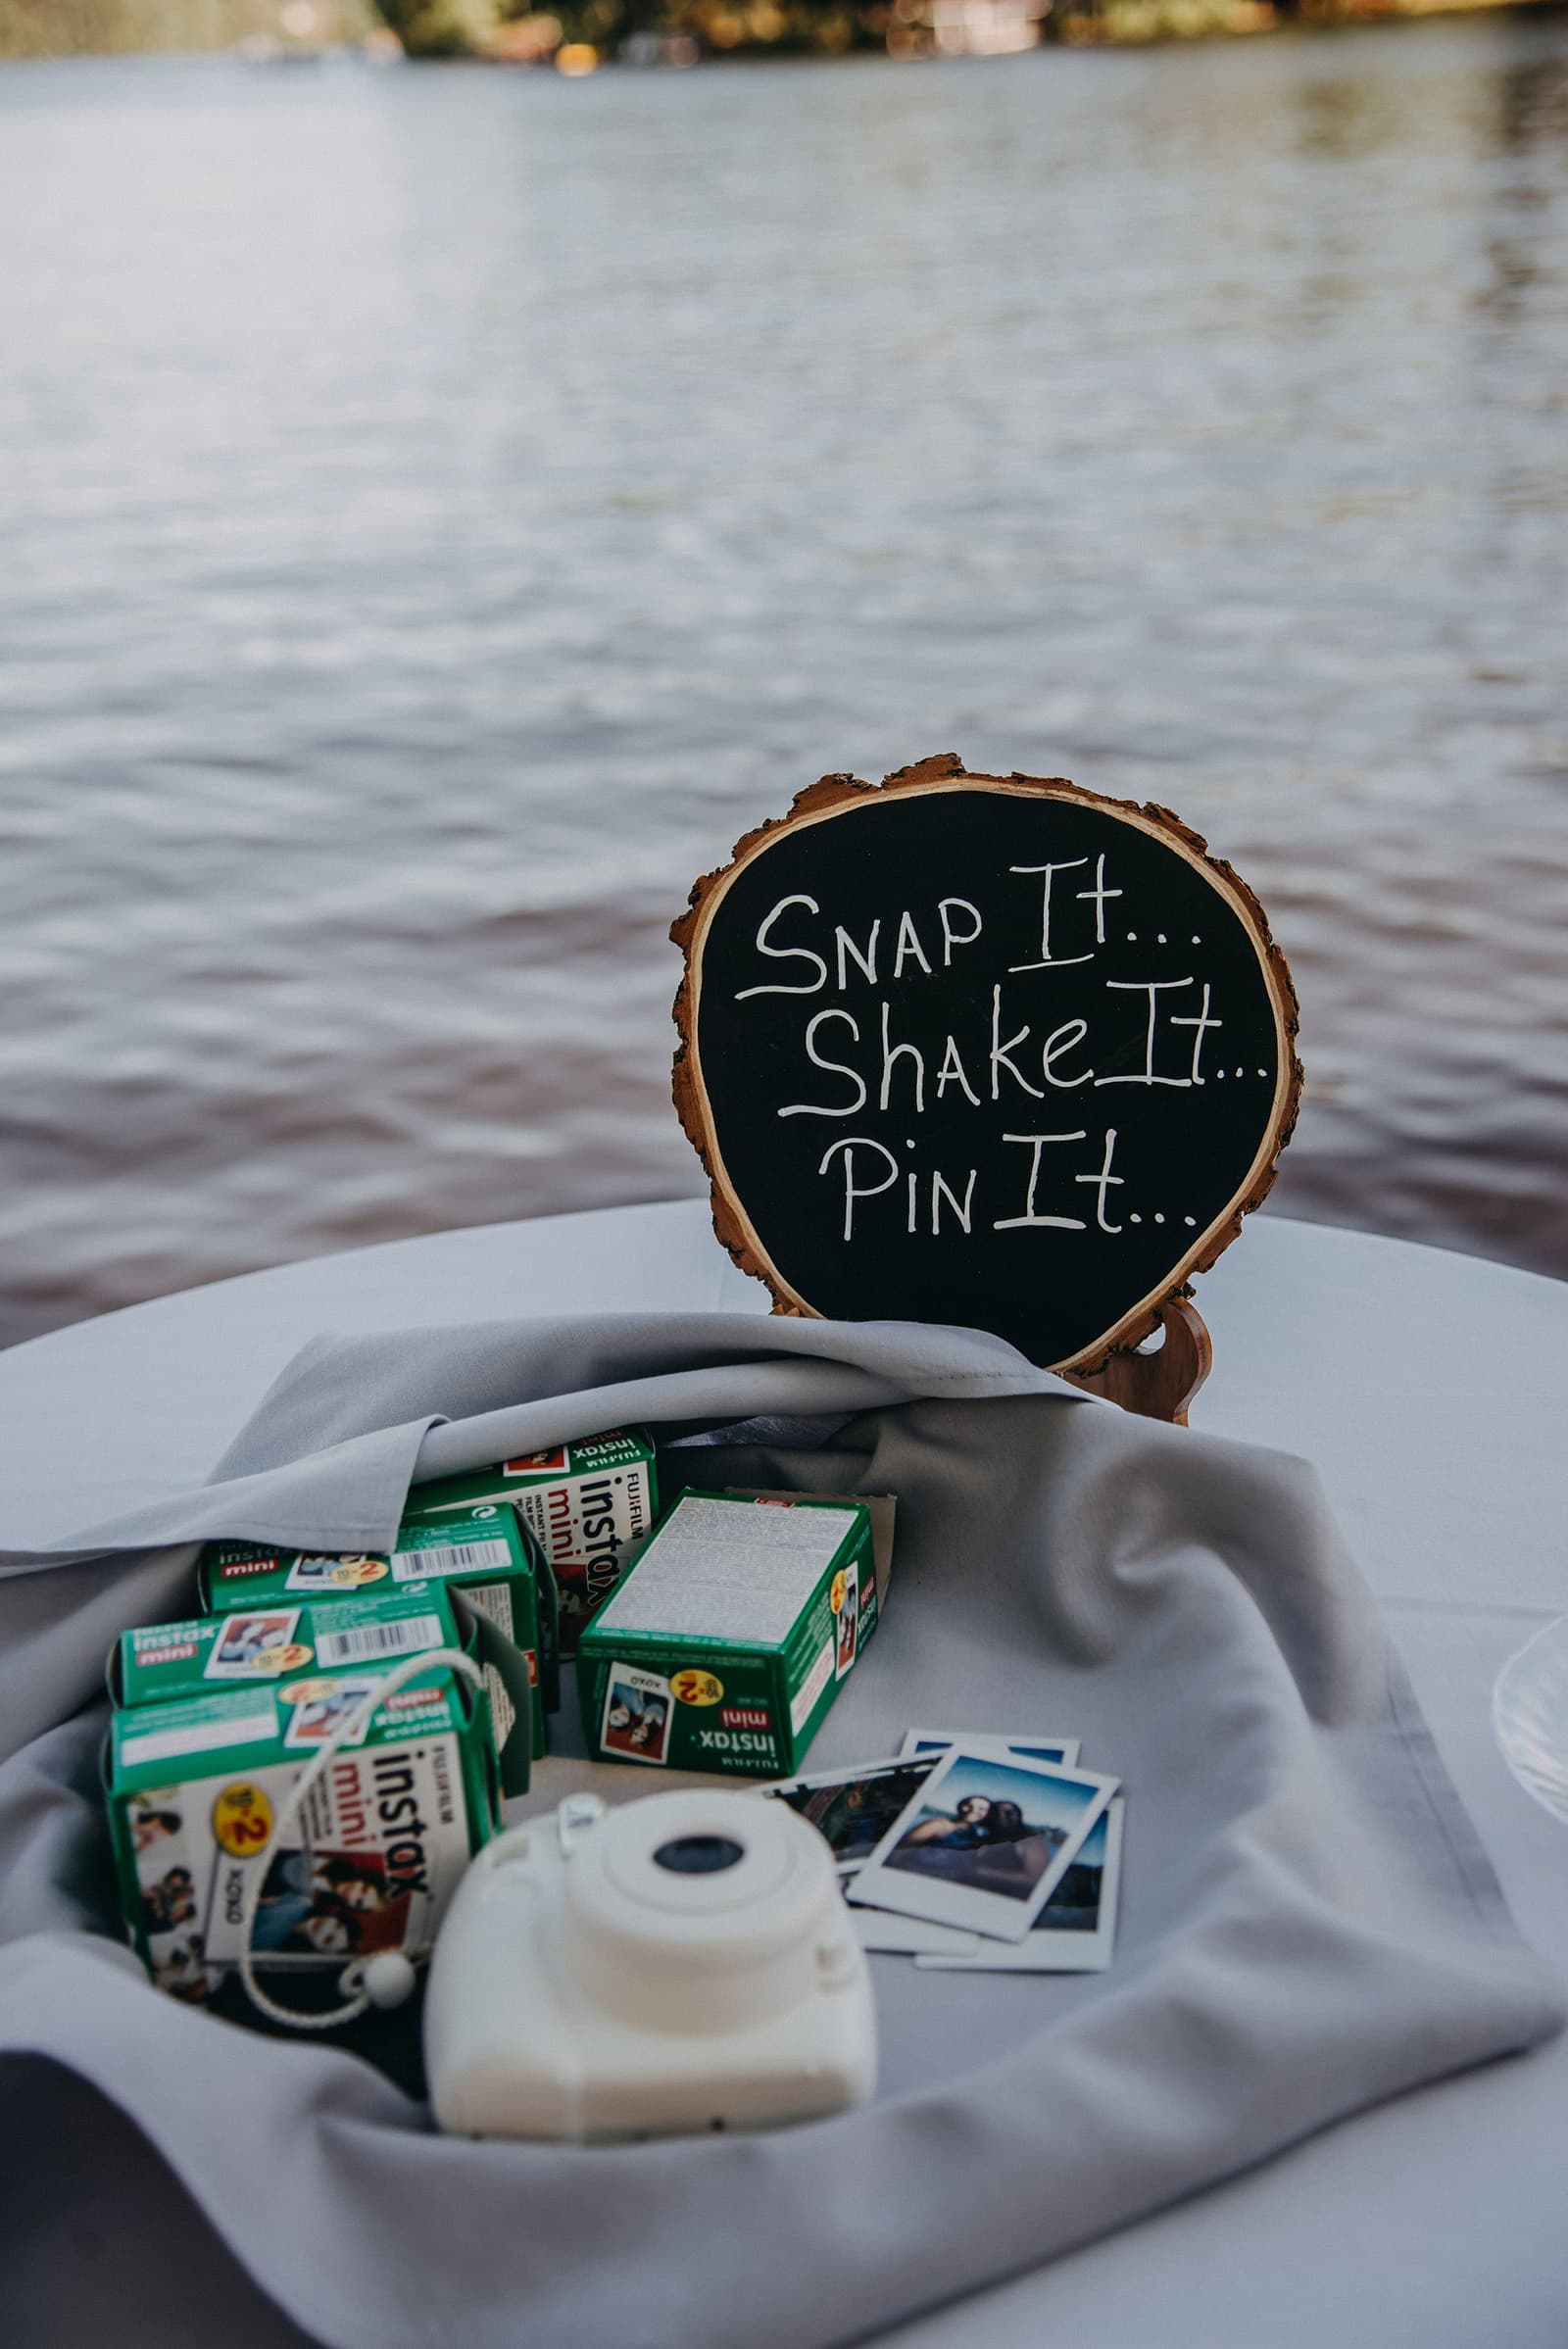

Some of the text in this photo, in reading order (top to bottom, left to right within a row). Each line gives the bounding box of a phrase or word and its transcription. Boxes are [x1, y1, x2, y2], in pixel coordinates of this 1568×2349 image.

[734, 894, 982, 1000] SNAP
[572, 1438, 636, 1459] instax
[534, 1493, 546, 1530] INSTANT
[626, 1472, 644, 1541] FUJIFILM
[547, 1488, 582, 1561] mini
[224, 1559, 274, 1576] mini
[132, 1626, 216, 1652] instax
[140, 1643, 194, 1665] mini
[721, 1708, 768, 1728] mini
[699, 1730, 777, 1758] instax
[333, 1762, 377, 1847] mini
[373, 1749, 428, 1899] instax
